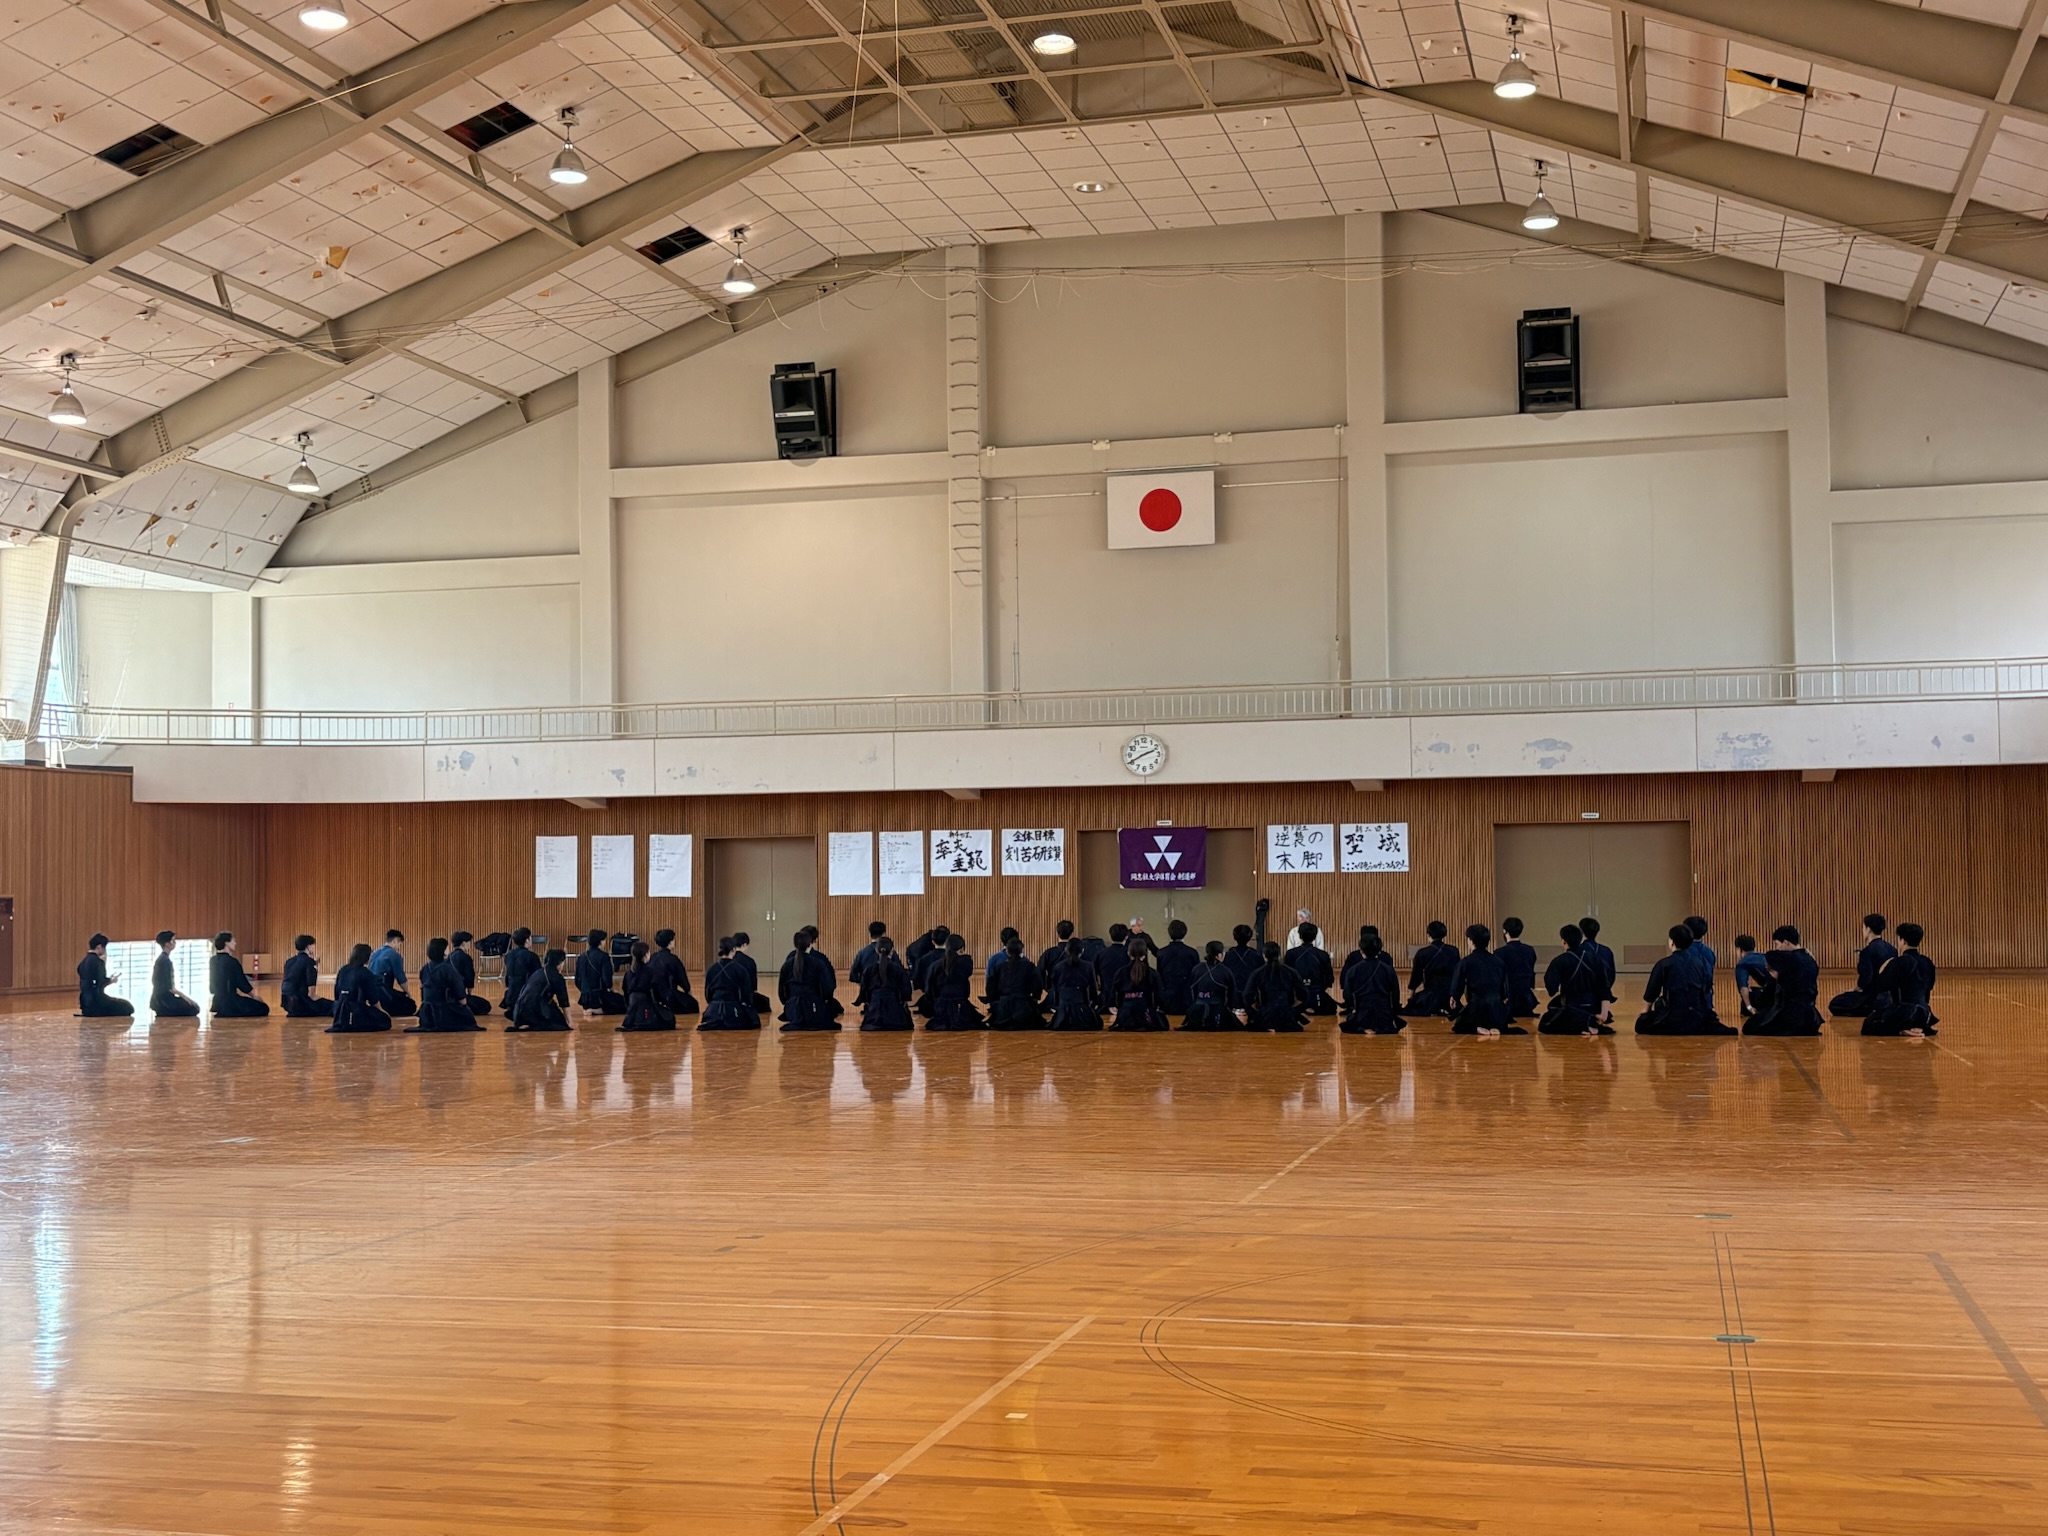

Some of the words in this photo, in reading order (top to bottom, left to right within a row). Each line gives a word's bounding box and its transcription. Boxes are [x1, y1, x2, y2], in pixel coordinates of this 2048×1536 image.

[1012, 830, 1056, 842] 全体目標
[1274, 831, 1324, 848] 逆襲の
[1344, 832, 1401, 855] 聖域
[1005, 845, 1062, 862] 刻苦研鑽
[1276, 850, 1323, 871] 末脚
